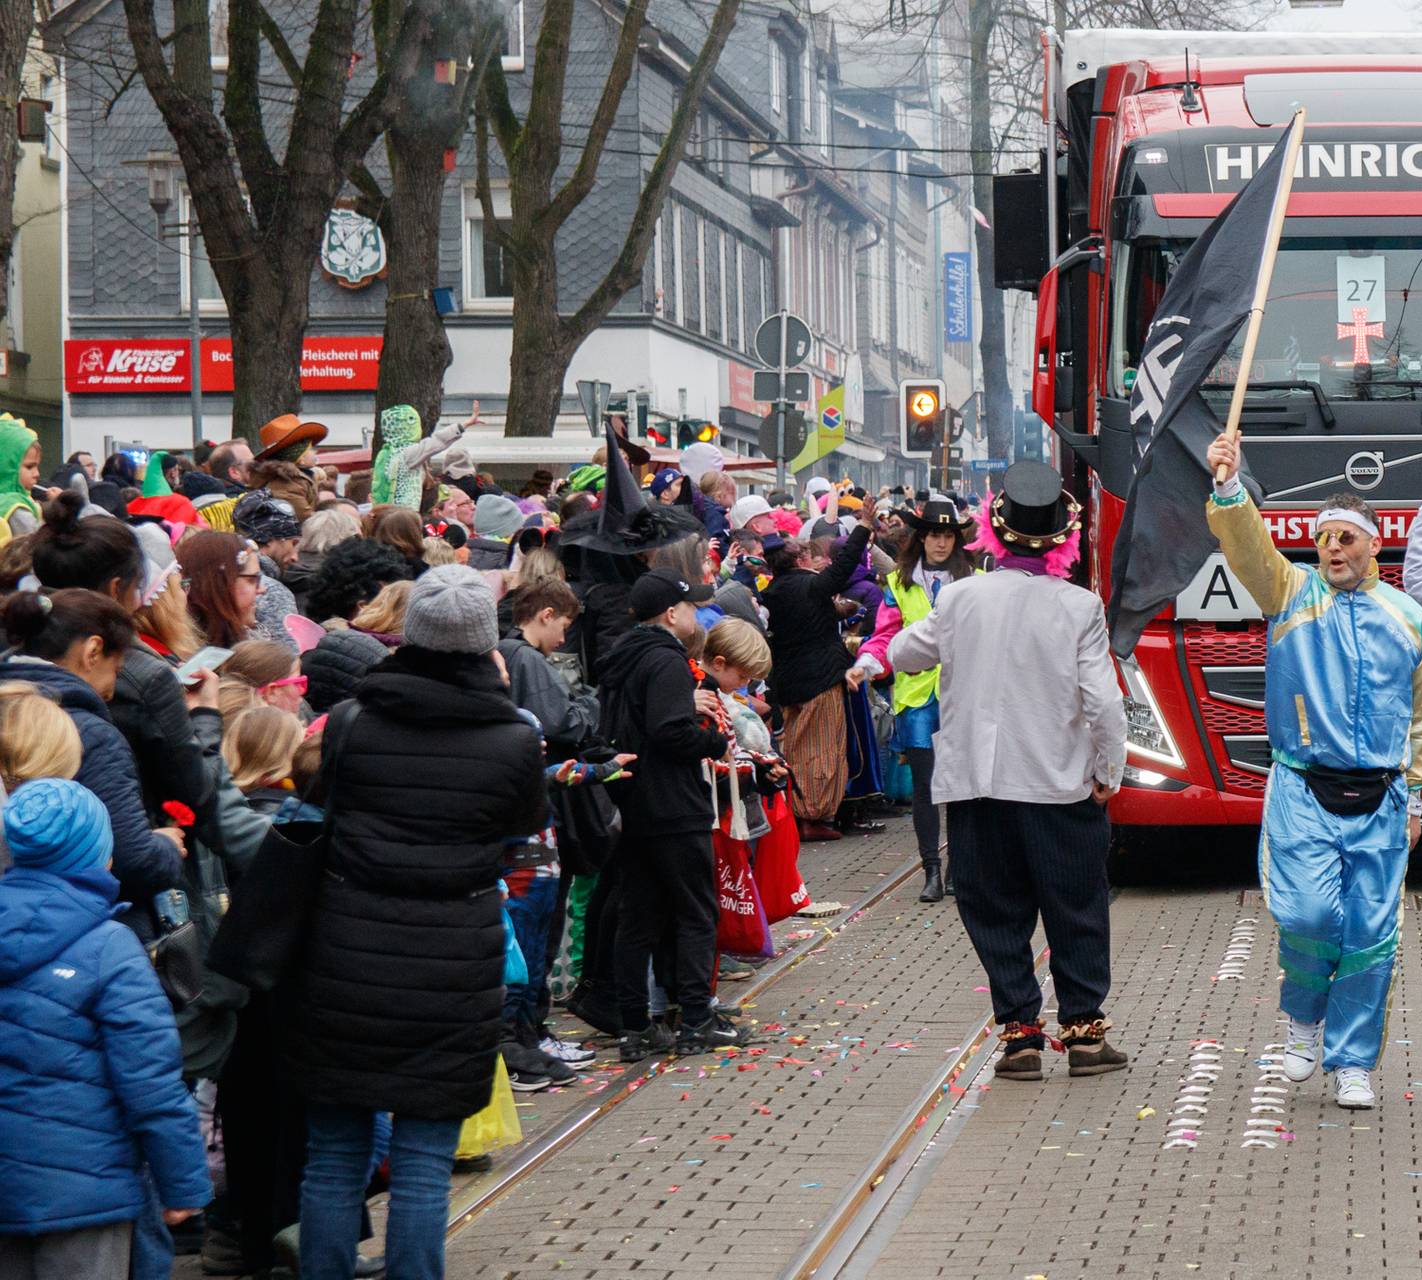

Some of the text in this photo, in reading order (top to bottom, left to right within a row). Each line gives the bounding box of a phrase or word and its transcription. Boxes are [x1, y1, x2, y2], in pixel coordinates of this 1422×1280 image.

[948, 256, 968, 337] Schülerhilfe!
[1346, 279, 1377, 302] 27
[106, 349, 177, 373] Kruse
[211, 351, 233, 362] Boc
[302, 348, 379, 361] Fleischerei mit
[134, 374, 143, 384] &
[1200, 564, 1239, 610] A
